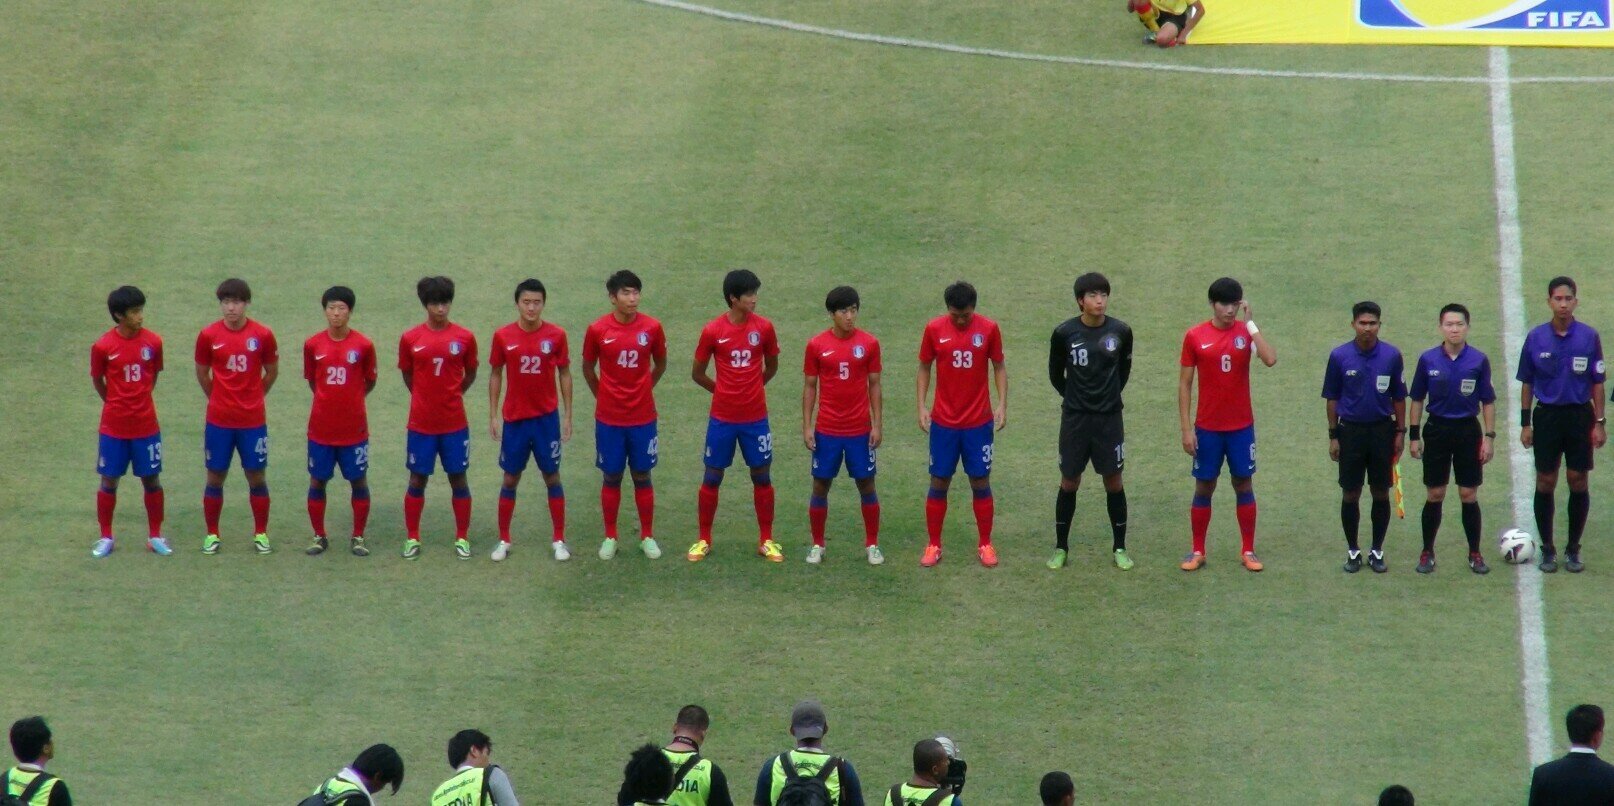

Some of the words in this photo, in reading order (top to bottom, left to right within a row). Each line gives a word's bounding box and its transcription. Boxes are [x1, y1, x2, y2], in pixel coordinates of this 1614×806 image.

[1527, 11, 1605, 28] FIFA
[226, 354, 247, 372] 43
[433, 357, 444, 376] 7
[520, 355, 541, 374] 22
[617, 350, 639, 368] 42
[730, 349, 752, 367] 32
[952, 350, 973, 368] 33
[1070, 349, 1089, 366] 18
[1221, 355, 1232, 373] 6
[123, 363, 141, 382] 13
[326, 366, 347, 385] 29
[839, 361, 850, 380] 5
[550, 440, 561, 458] 2
